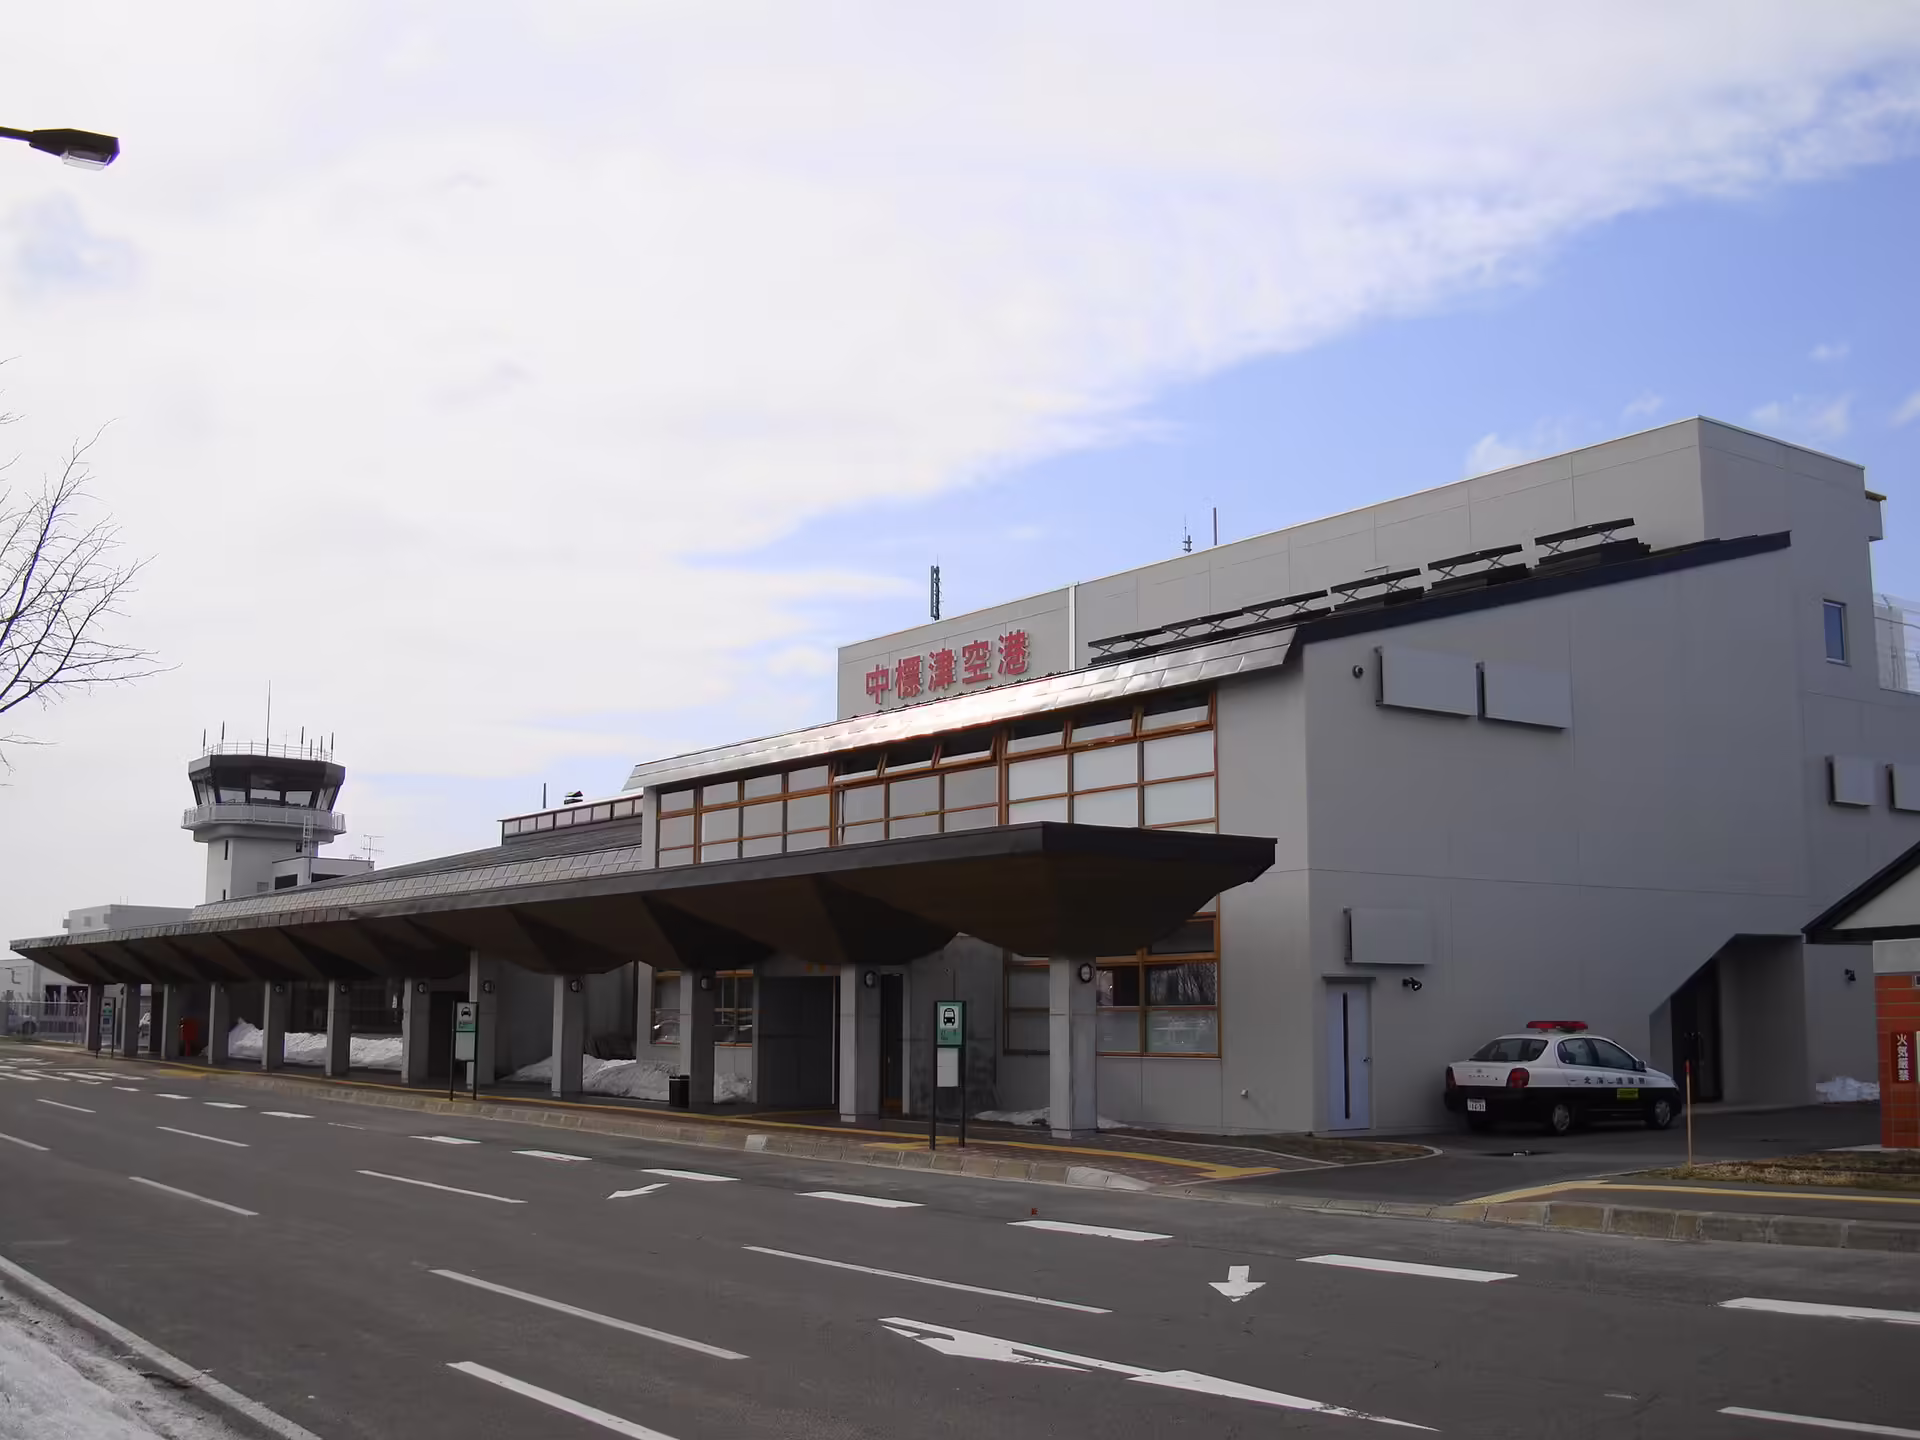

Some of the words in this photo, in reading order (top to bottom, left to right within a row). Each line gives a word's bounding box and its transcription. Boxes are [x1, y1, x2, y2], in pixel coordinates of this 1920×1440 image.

[866, 629, 1030, 705] 中標津空港
[1896, 1033, 1910, 1081] 火気厳禁
